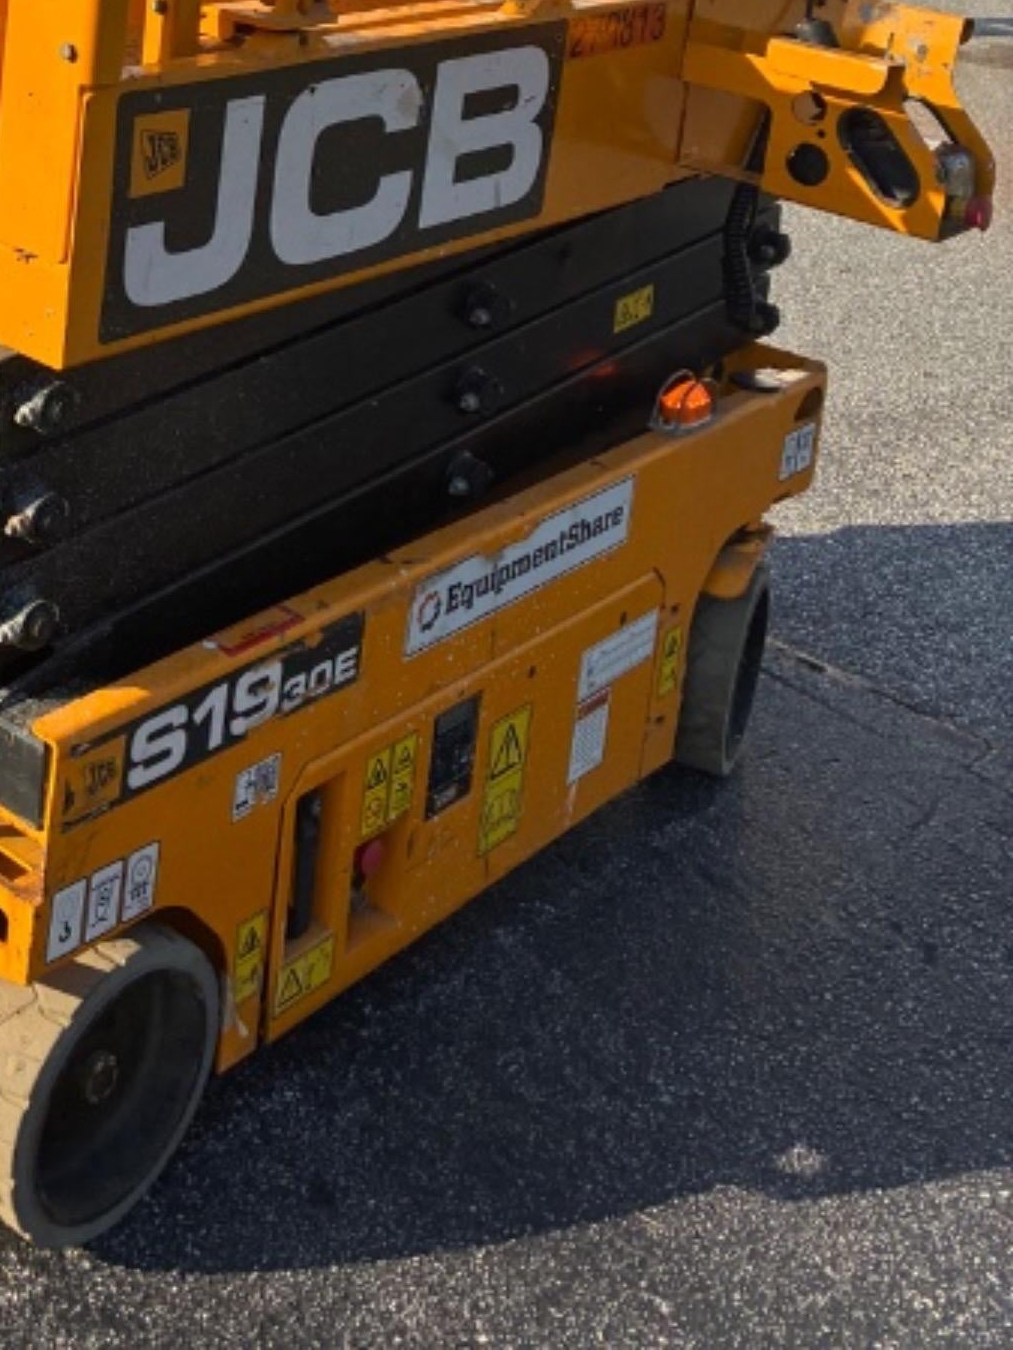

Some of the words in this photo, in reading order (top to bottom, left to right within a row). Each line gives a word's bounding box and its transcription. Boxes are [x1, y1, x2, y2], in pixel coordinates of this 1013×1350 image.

[570, 2, 666, 58] 29813
[124, 45, 550, 307] JCB
[445, 505, 625, 614] EquipmentShare
